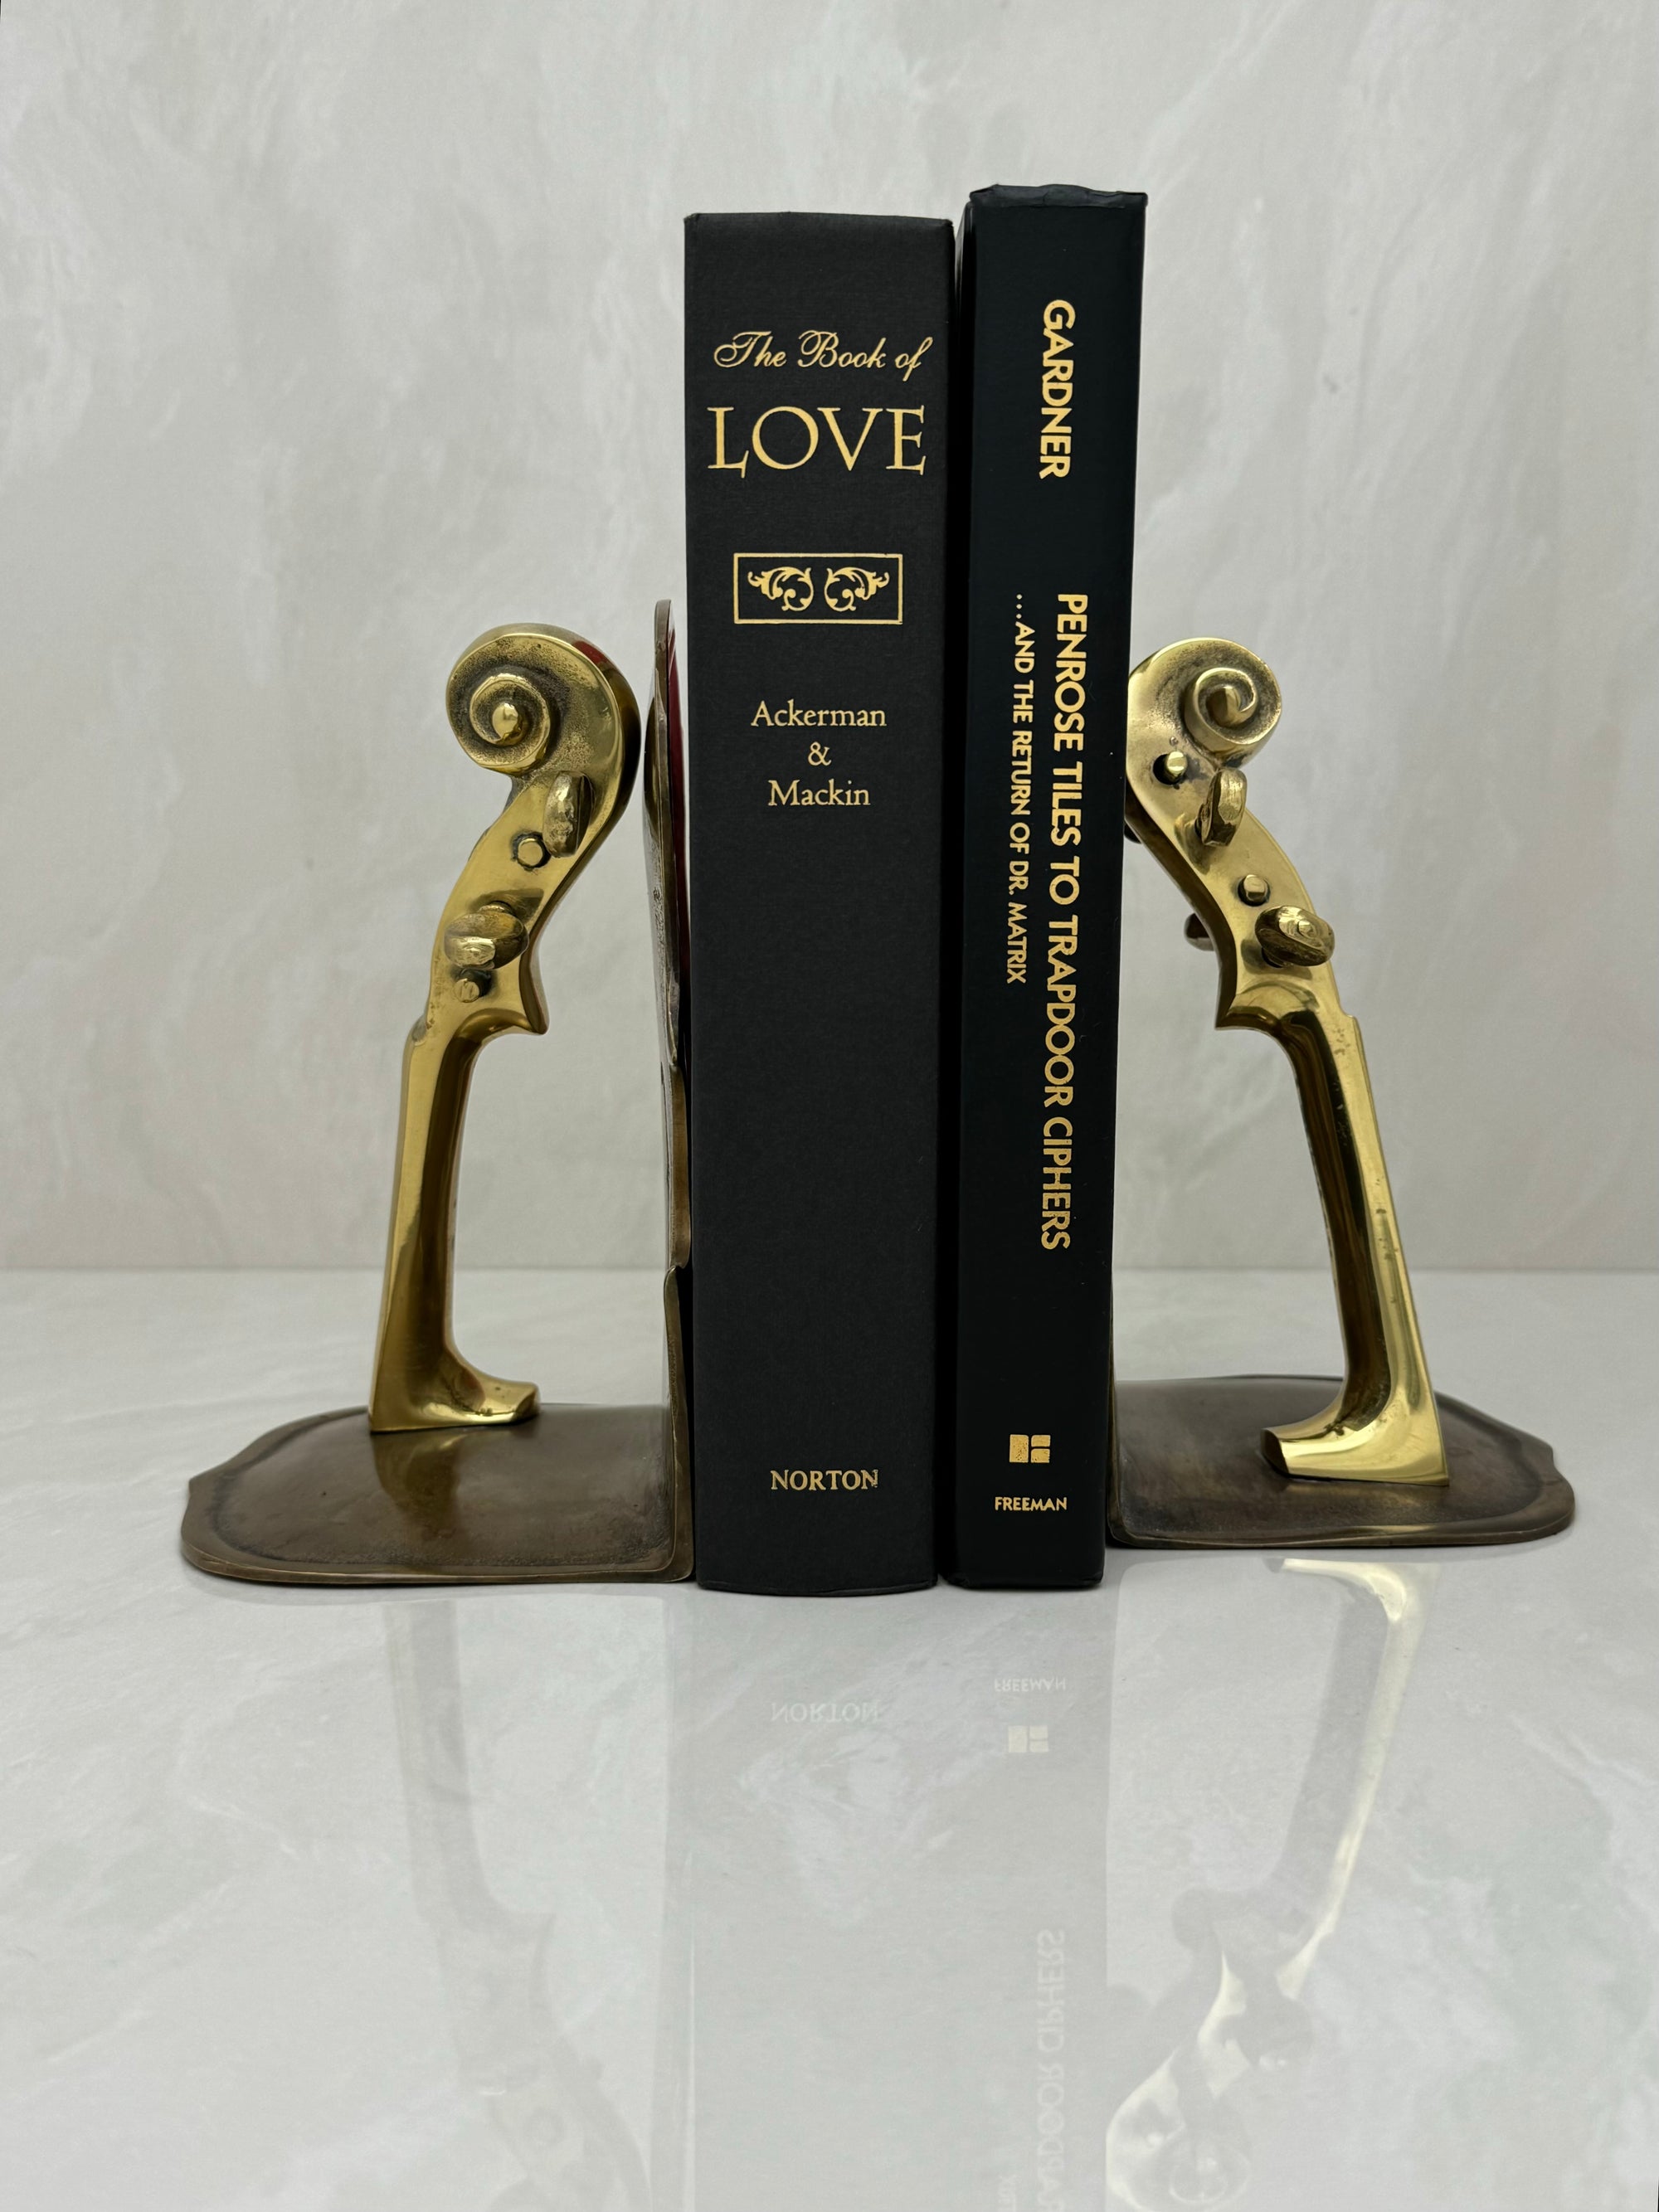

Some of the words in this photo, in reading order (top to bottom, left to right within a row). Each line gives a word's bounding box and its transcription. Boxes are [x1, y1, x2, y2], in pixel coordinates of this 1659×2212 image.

[713, 330, 786, 368] The
[796, 329, 887, 369] Book
[894, 336, 934, 382] of
[1039, 299, 1076, 479] GARDNER
[707, 405, 927, 479] LOVE
[1053, 593, 1088, 752] PENROSE
[750, 698, 888, 727] Ackerman
[1012, 679, 1034, 724] THE
[807, 741, 832, 766] &
[1010, 730, 1033, 815] RETURN
[767, 778, 871, 806] Mackin
[1050, 761, 1083, 847] TILES
[1009, 822, 1030, 854] OF
[1008, 860, 1029, 896] DR.
[1048, 855, 1080, 906] TO
[1006, 902, 1028, 984] MATRIX
[1044, 914, 1078, 1108] TRAPDOOR
[1041, 1116, 1073, 1250] CIPHERS
[770, 1470, 879, 1491] NORTON
[995, 1496, 1068, 1512] FREEMAN
